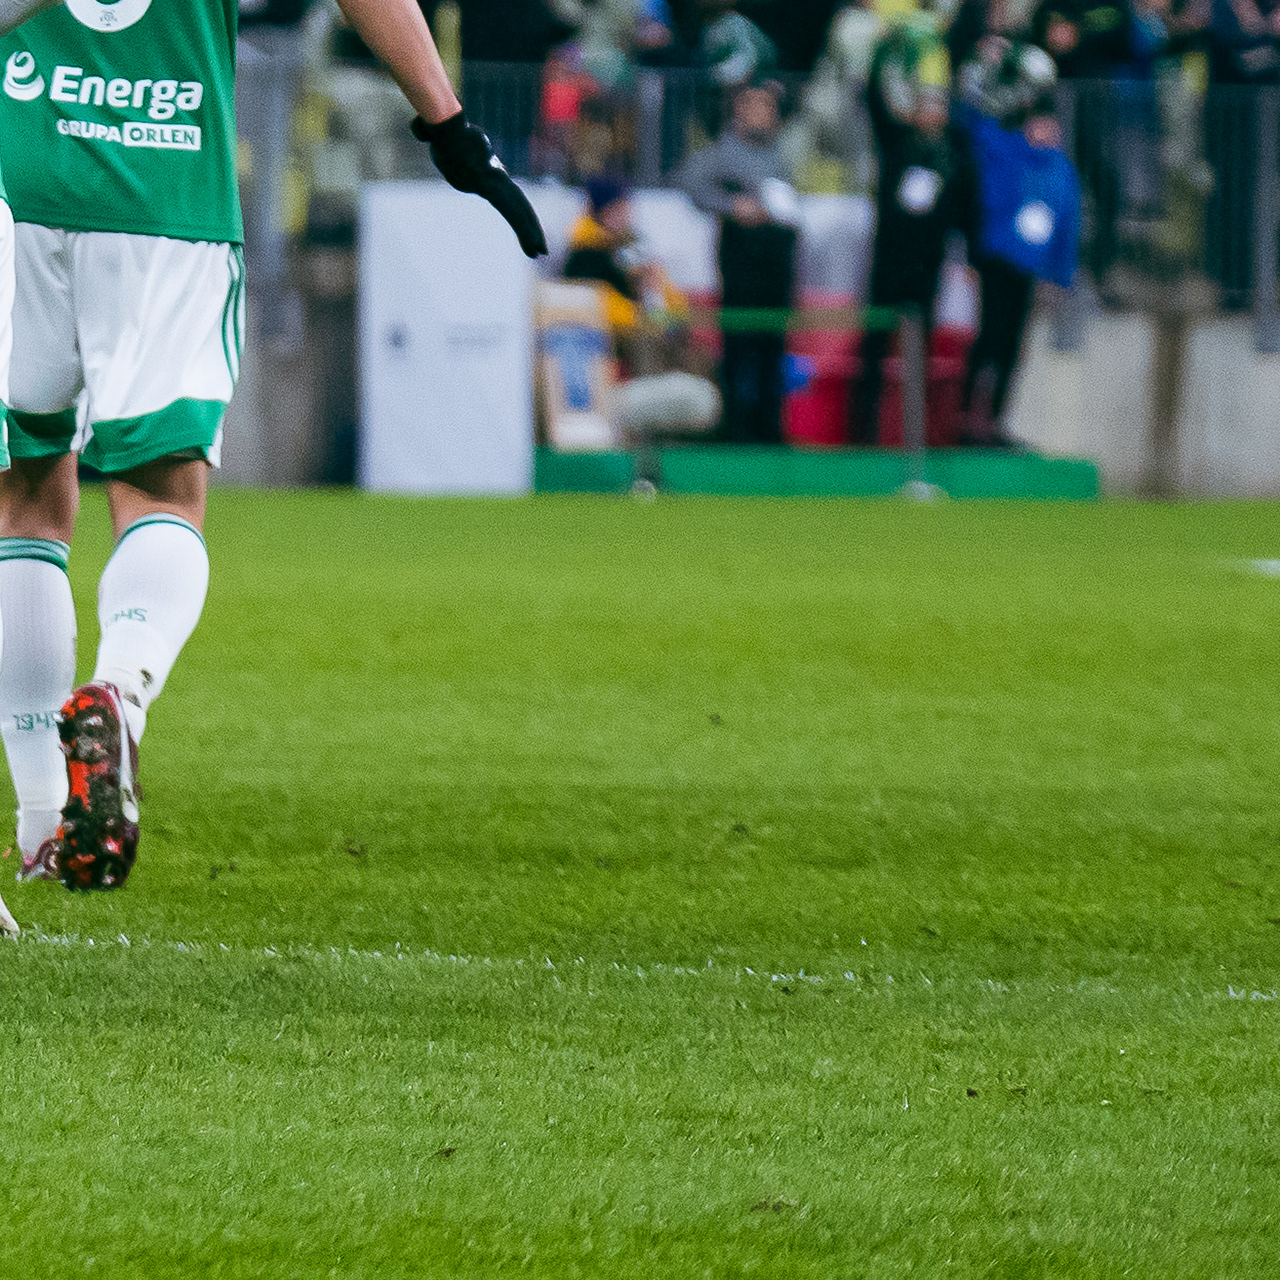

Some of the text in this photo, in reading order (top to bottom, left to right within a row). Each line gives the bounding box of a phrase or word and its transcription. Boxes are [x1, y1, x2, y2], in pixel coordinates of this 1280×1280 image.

[49, 65, 204, 121] Energa
[56, 119, 196, 146] GRUPA ORLEN
